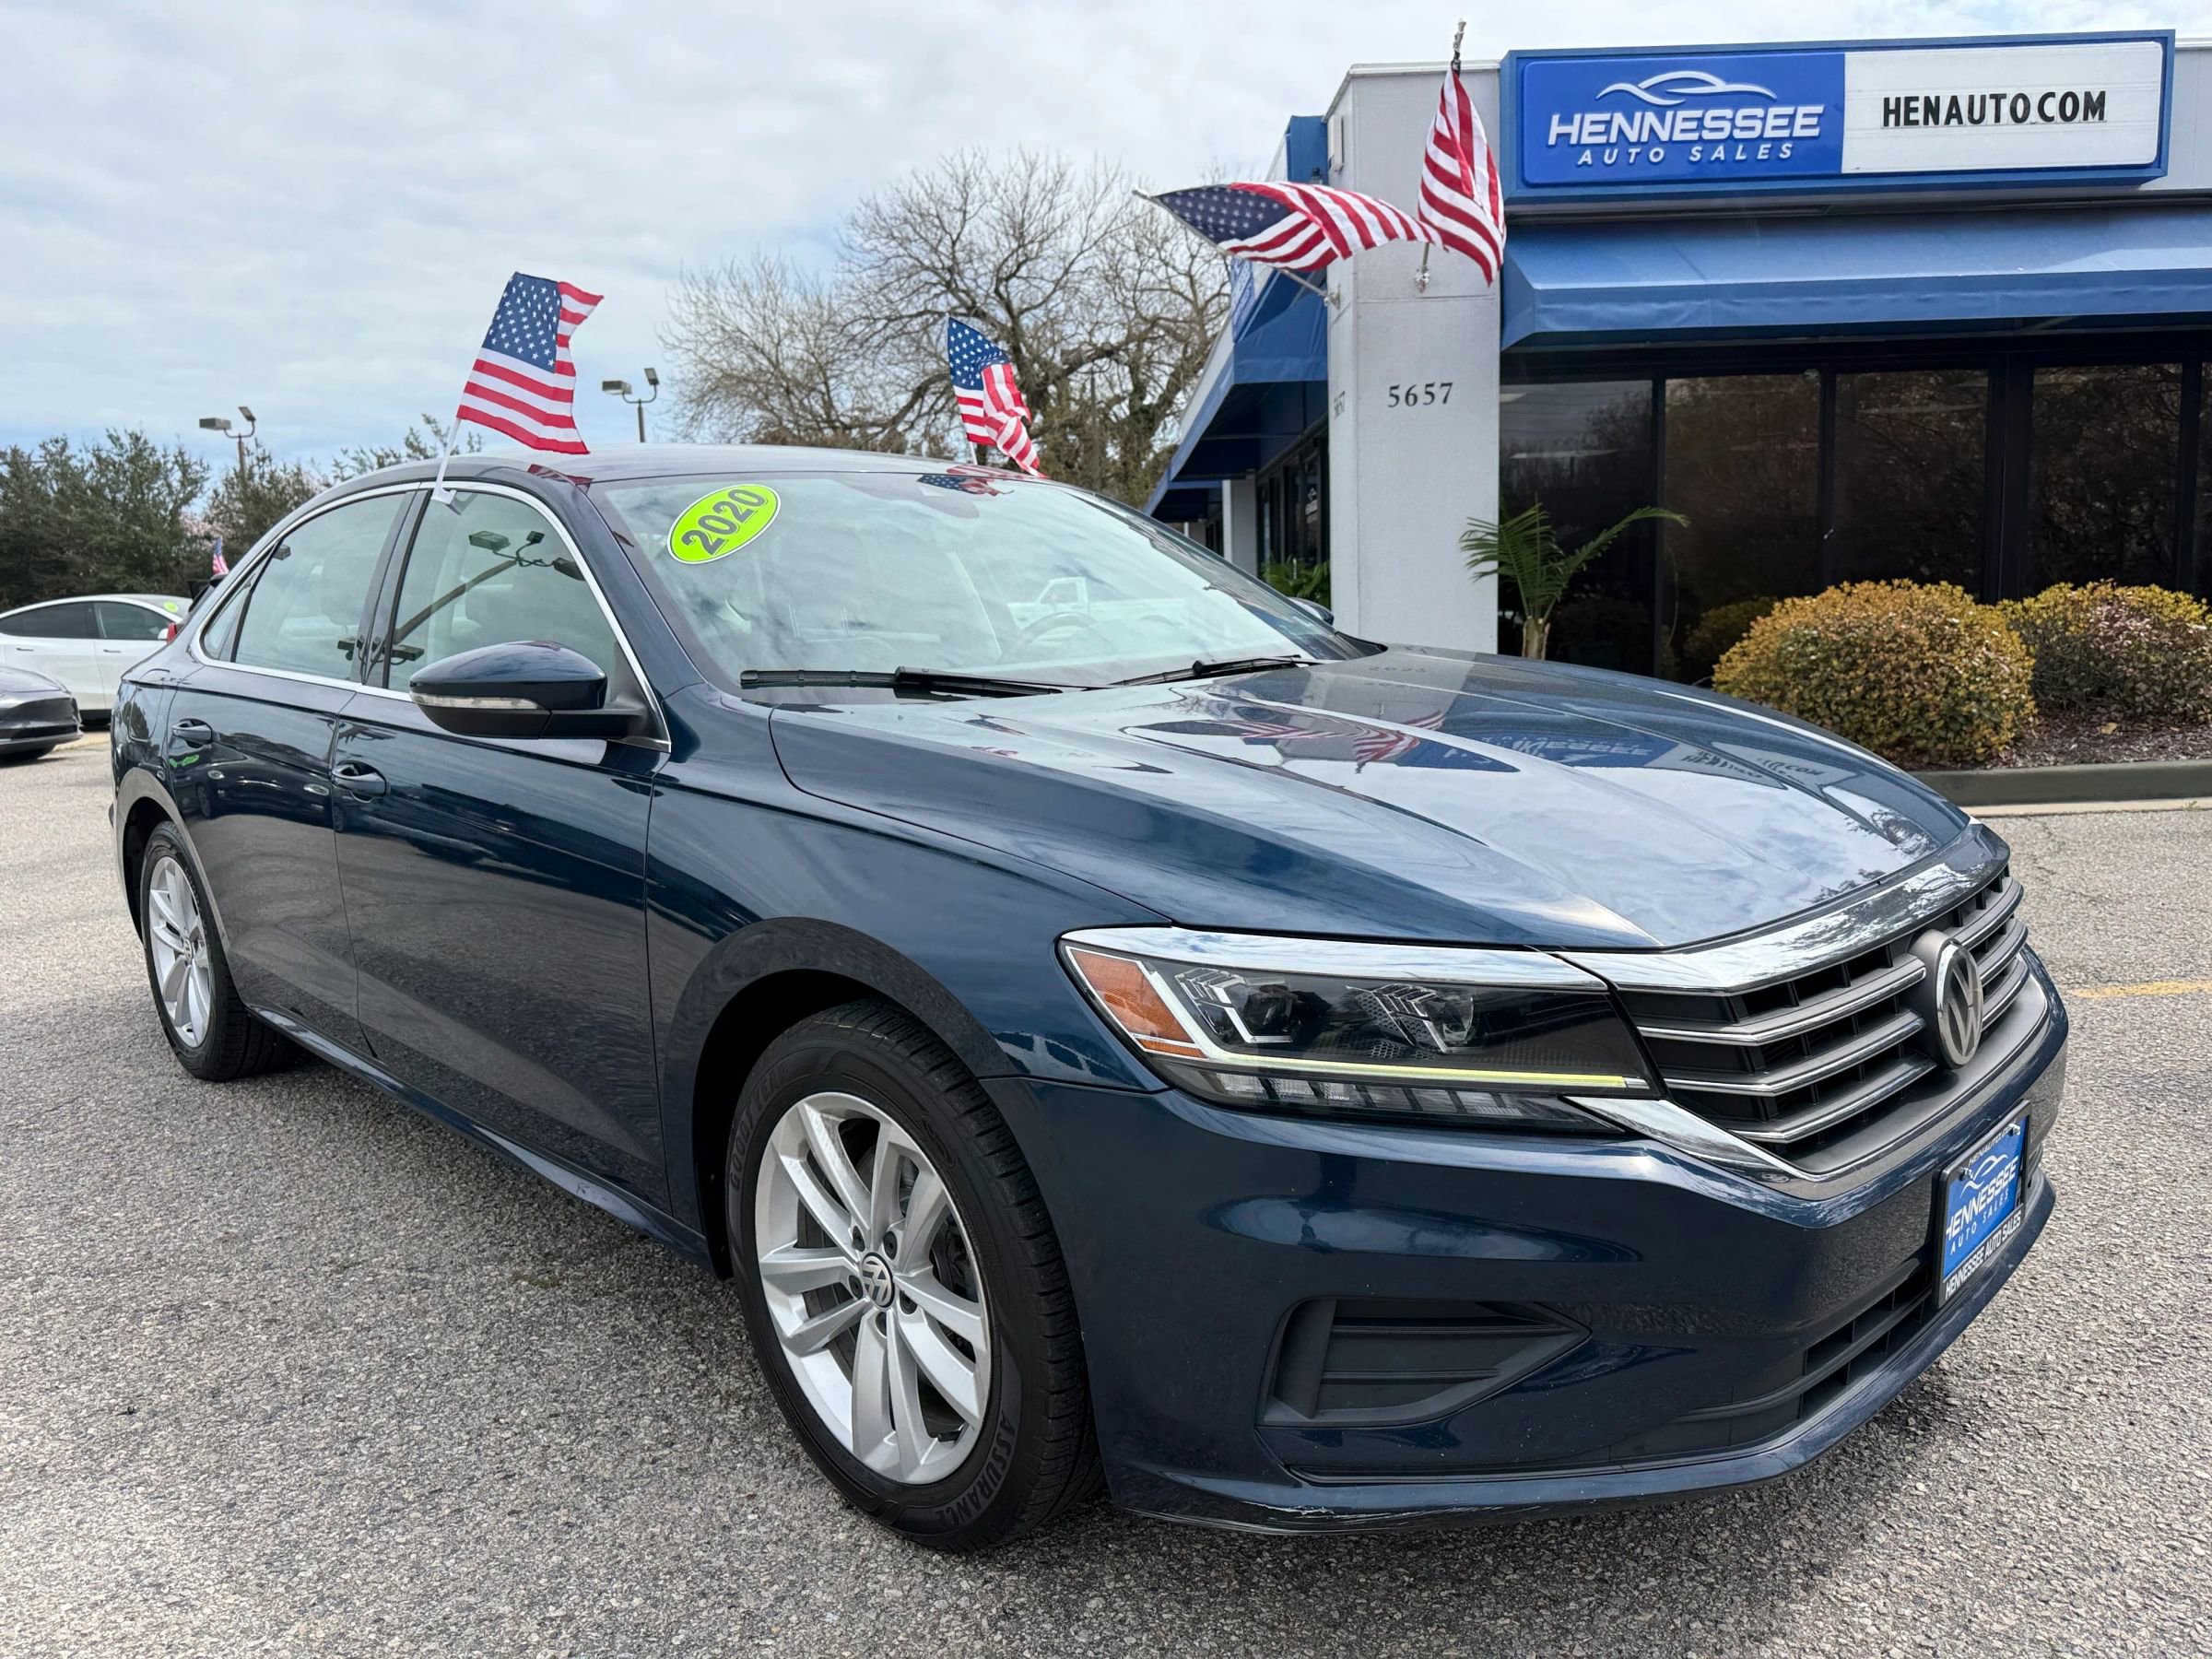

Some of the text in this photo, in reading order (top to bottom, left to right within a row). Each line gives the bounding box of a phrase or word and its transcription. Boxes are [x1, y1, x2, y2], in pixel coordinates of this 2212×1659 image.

[1547, 104, 1825, 146] HENNESSEE
[1882, 90, 2107, 127] HENAUTO.COM
[1577, 143, 1794, 166] AUTO SALES
[1386, 382, 1454, 408] 5657
[680, 488, 769, 556] 2020
[1950, 1187, 2010, 1255] AUTO SALES
[1945, 1209, 2022, 1300] HENNESSEE AUTO SALES
[935, 1409, 1016, 1527] ASSURANCE
